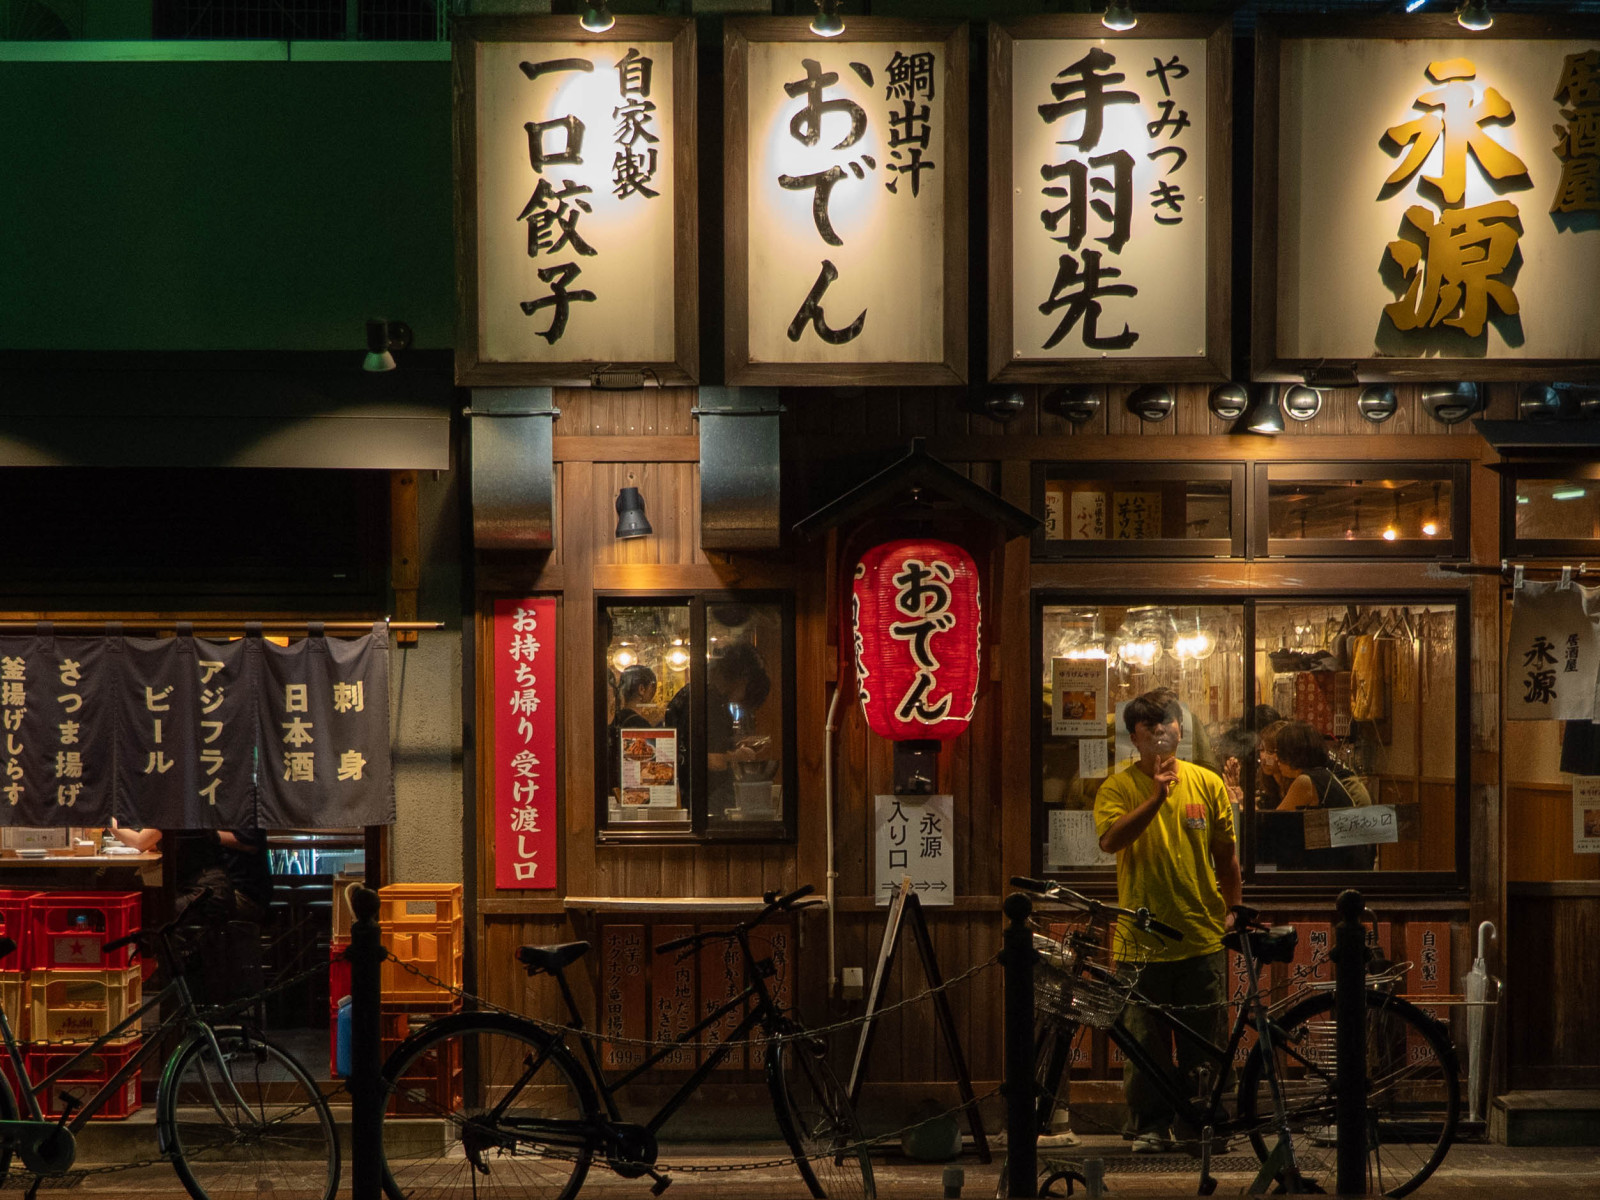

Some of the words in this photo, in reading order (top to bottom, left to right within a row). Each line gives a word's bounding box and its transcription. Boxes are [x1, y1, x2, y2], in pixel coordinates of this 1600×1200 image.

[611, 47, 661, 201] 自家製
[885, 50, 936, 199] 鯛出汁
[1146, 54, 1191, 227] やみつき
[516, 57, 599, 346] 一口餃子
[778, 58, 877, 346] おでん
[1037, 46, 1141, 351] 手羽先
[1378, 57, 1532, 340] 永源
[508, 607, 542, 745] お持ち帰り
[888, 558, 956, 725] おでん
[1523, 636, 1559, 705] 永源
[1564, 633, 1580, 673] 居酒屋
[1, 655, 27, 807] 釜揚げしらす
[55, 658, 84, 808] さつま揚げ
[144, 685, 175, 775] ビール
[198, 659, 226, 806] アジフライ
[282, 683, 315, 783] 日本酒
[333, 680, 368, 783] 刺身
[509, 749, 542, 881] 受け渡し口
[887, 801, 910, 870] 入り口
[919, 812, 943, 860] 永源
